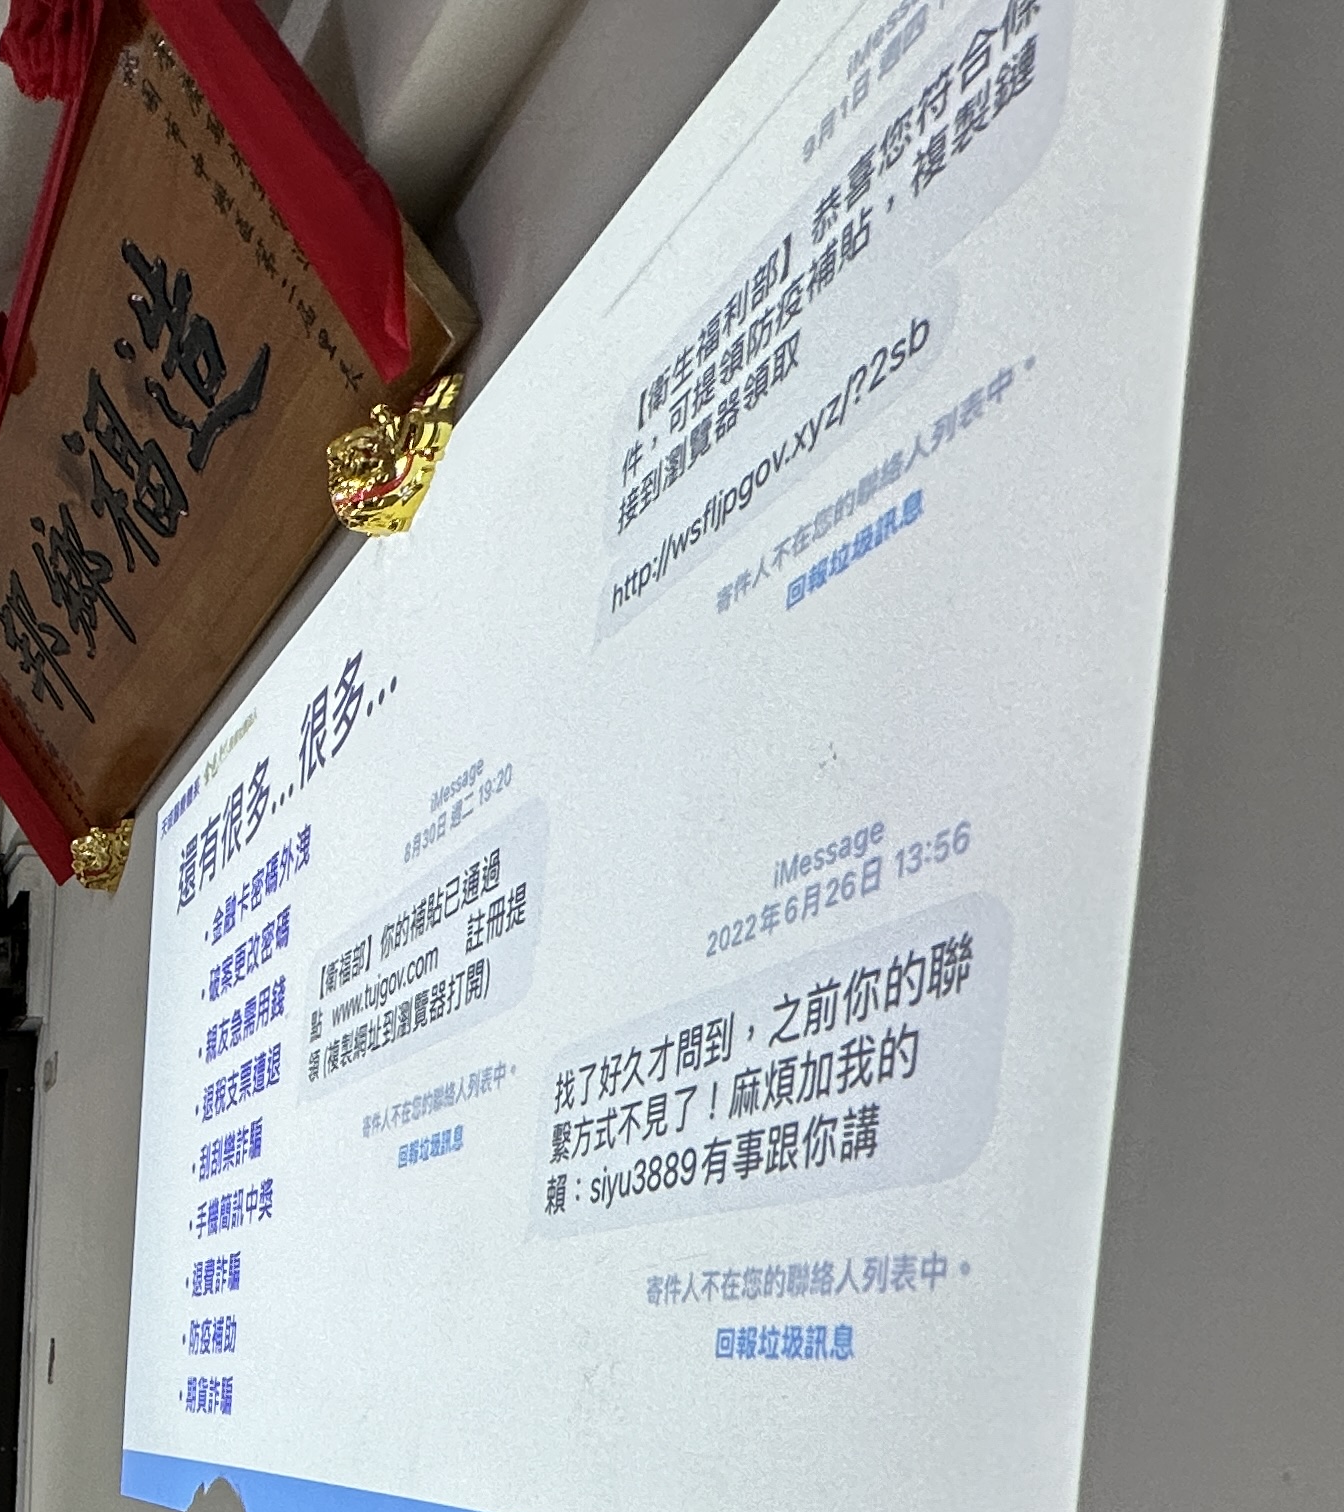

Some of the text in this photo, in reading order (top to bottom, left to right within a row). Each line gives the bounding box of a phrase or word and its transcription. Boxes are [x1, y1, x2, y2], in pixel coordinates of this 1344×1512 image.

[617, 331, 801, 536] 接到瀏覽器領取
[785, 489, 924, 611] 回報垃圾訊息
[478, 764, 513, 807] 19:20
[706, 820, 970, 958] 2022年6月26日 13:56
[773, 820, 883, 889] iMessage
[465, 882, 528, 953] 註冊提
[209, 905, 291, 1003] 破案更改密碼
[204, 976, 287, 1063] 親友急需用錢
[555, 931, 974, 1115] 找了好久才問到，之前你的聯
[201, 1042, 282, 1124] 退稅支票遭退
[551, 1022, 919, 1164] 繫方式不見了！麻煩加我的
[198, 1118, 263, 1181] 刮刮樂詐騙
[195, 1178, 274, 1240] 手機簡訊中獎
[191, 1252, 241, 1299] 退費詐騙
[188, 1315, 237, 1356] 防疫補助
[715, 1324, 854, 1361] 回報垃圾訊息
[185, 1375, 233, 1417] 期貨詐騙
